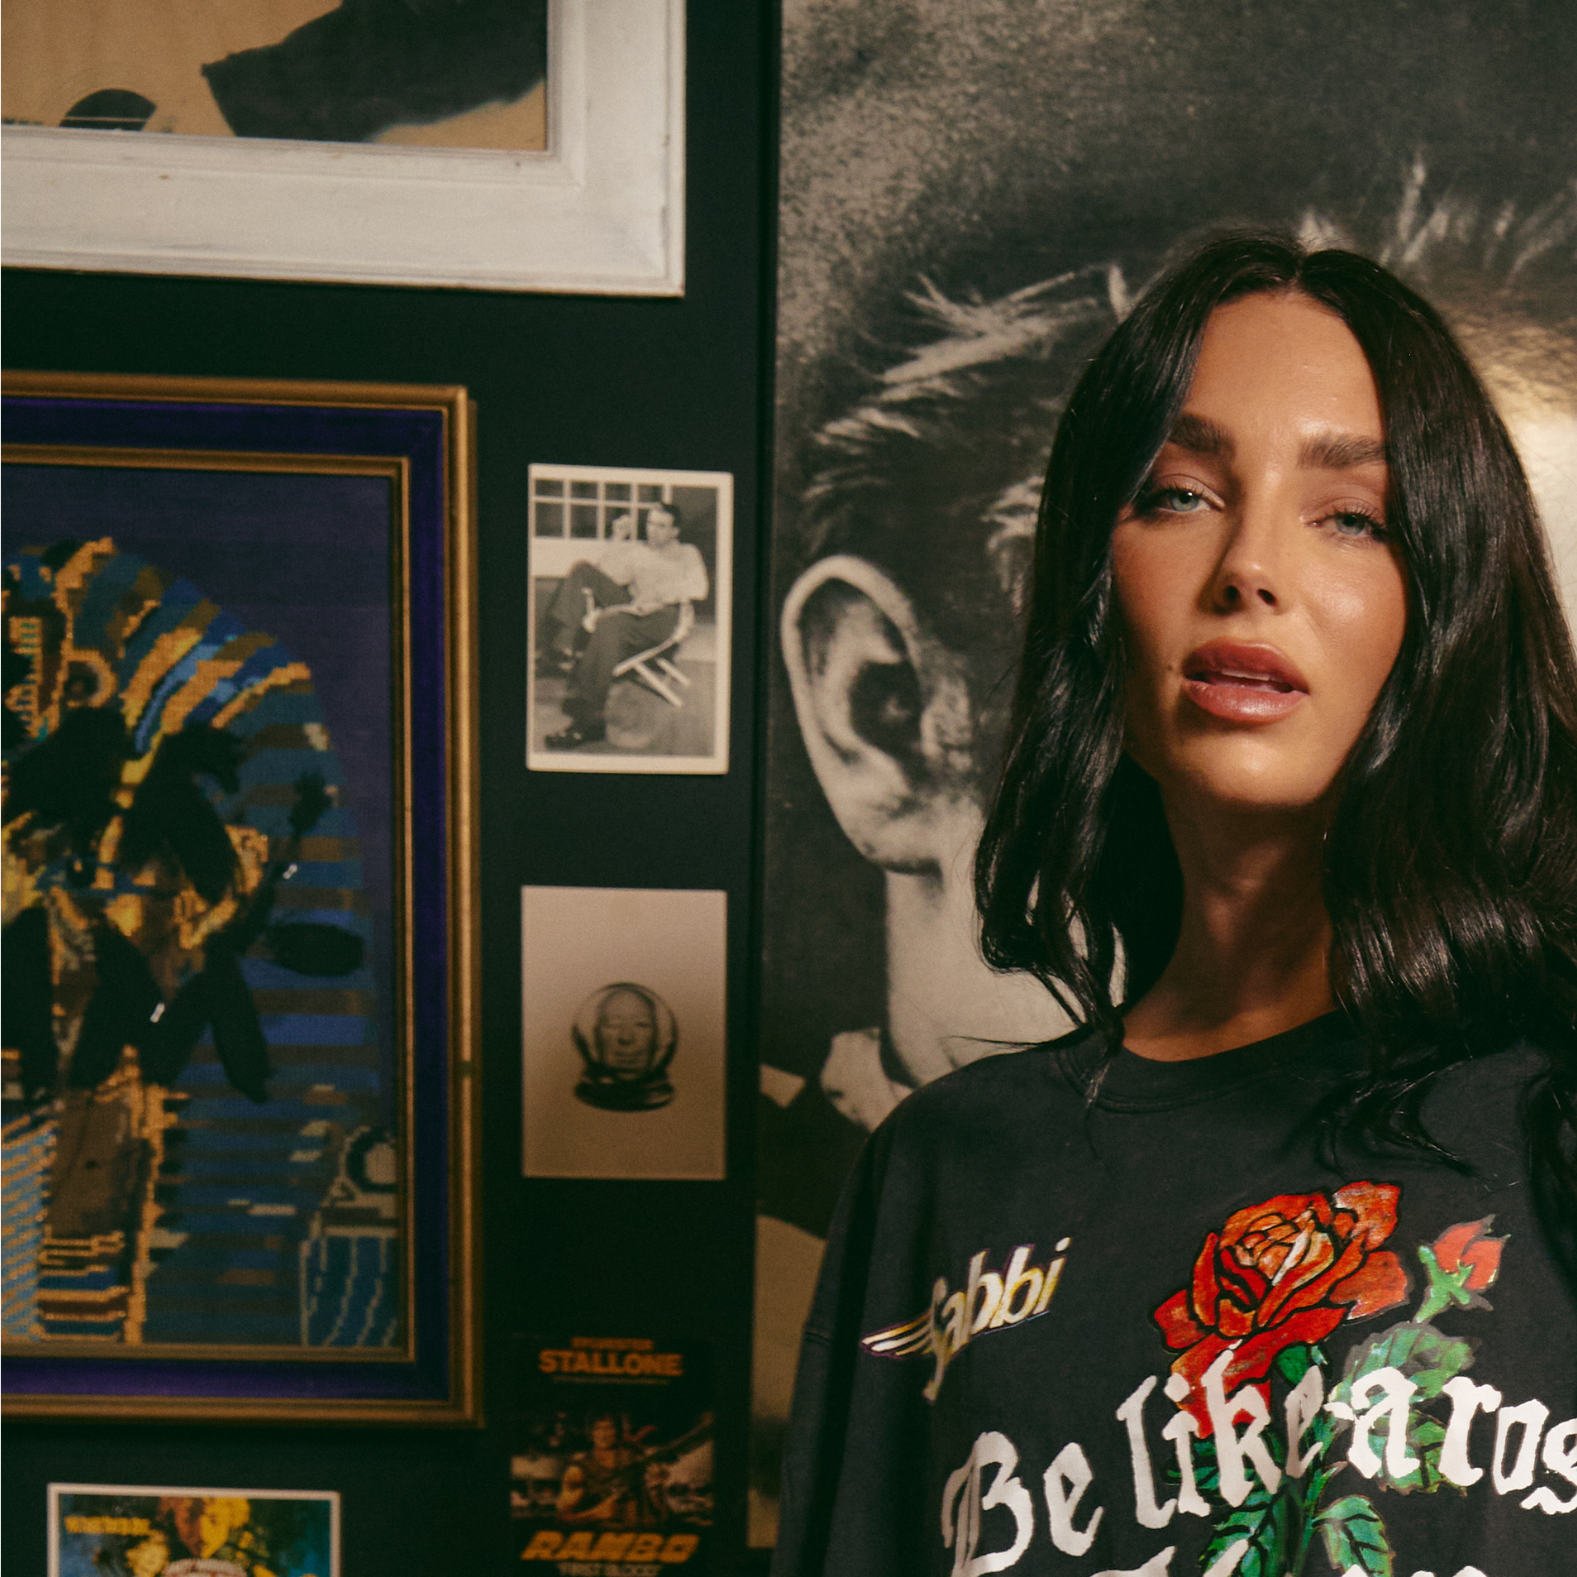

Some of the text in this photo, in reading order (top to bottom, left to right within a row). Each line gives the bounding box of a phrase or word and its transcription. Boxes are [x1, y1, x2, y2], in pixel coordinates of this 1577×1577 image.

[538, 1349, 684, 1377] STALLONE
[1114, 1338, 1326, 1530] like
[520, 1530, 700, 1564] RAMBO
